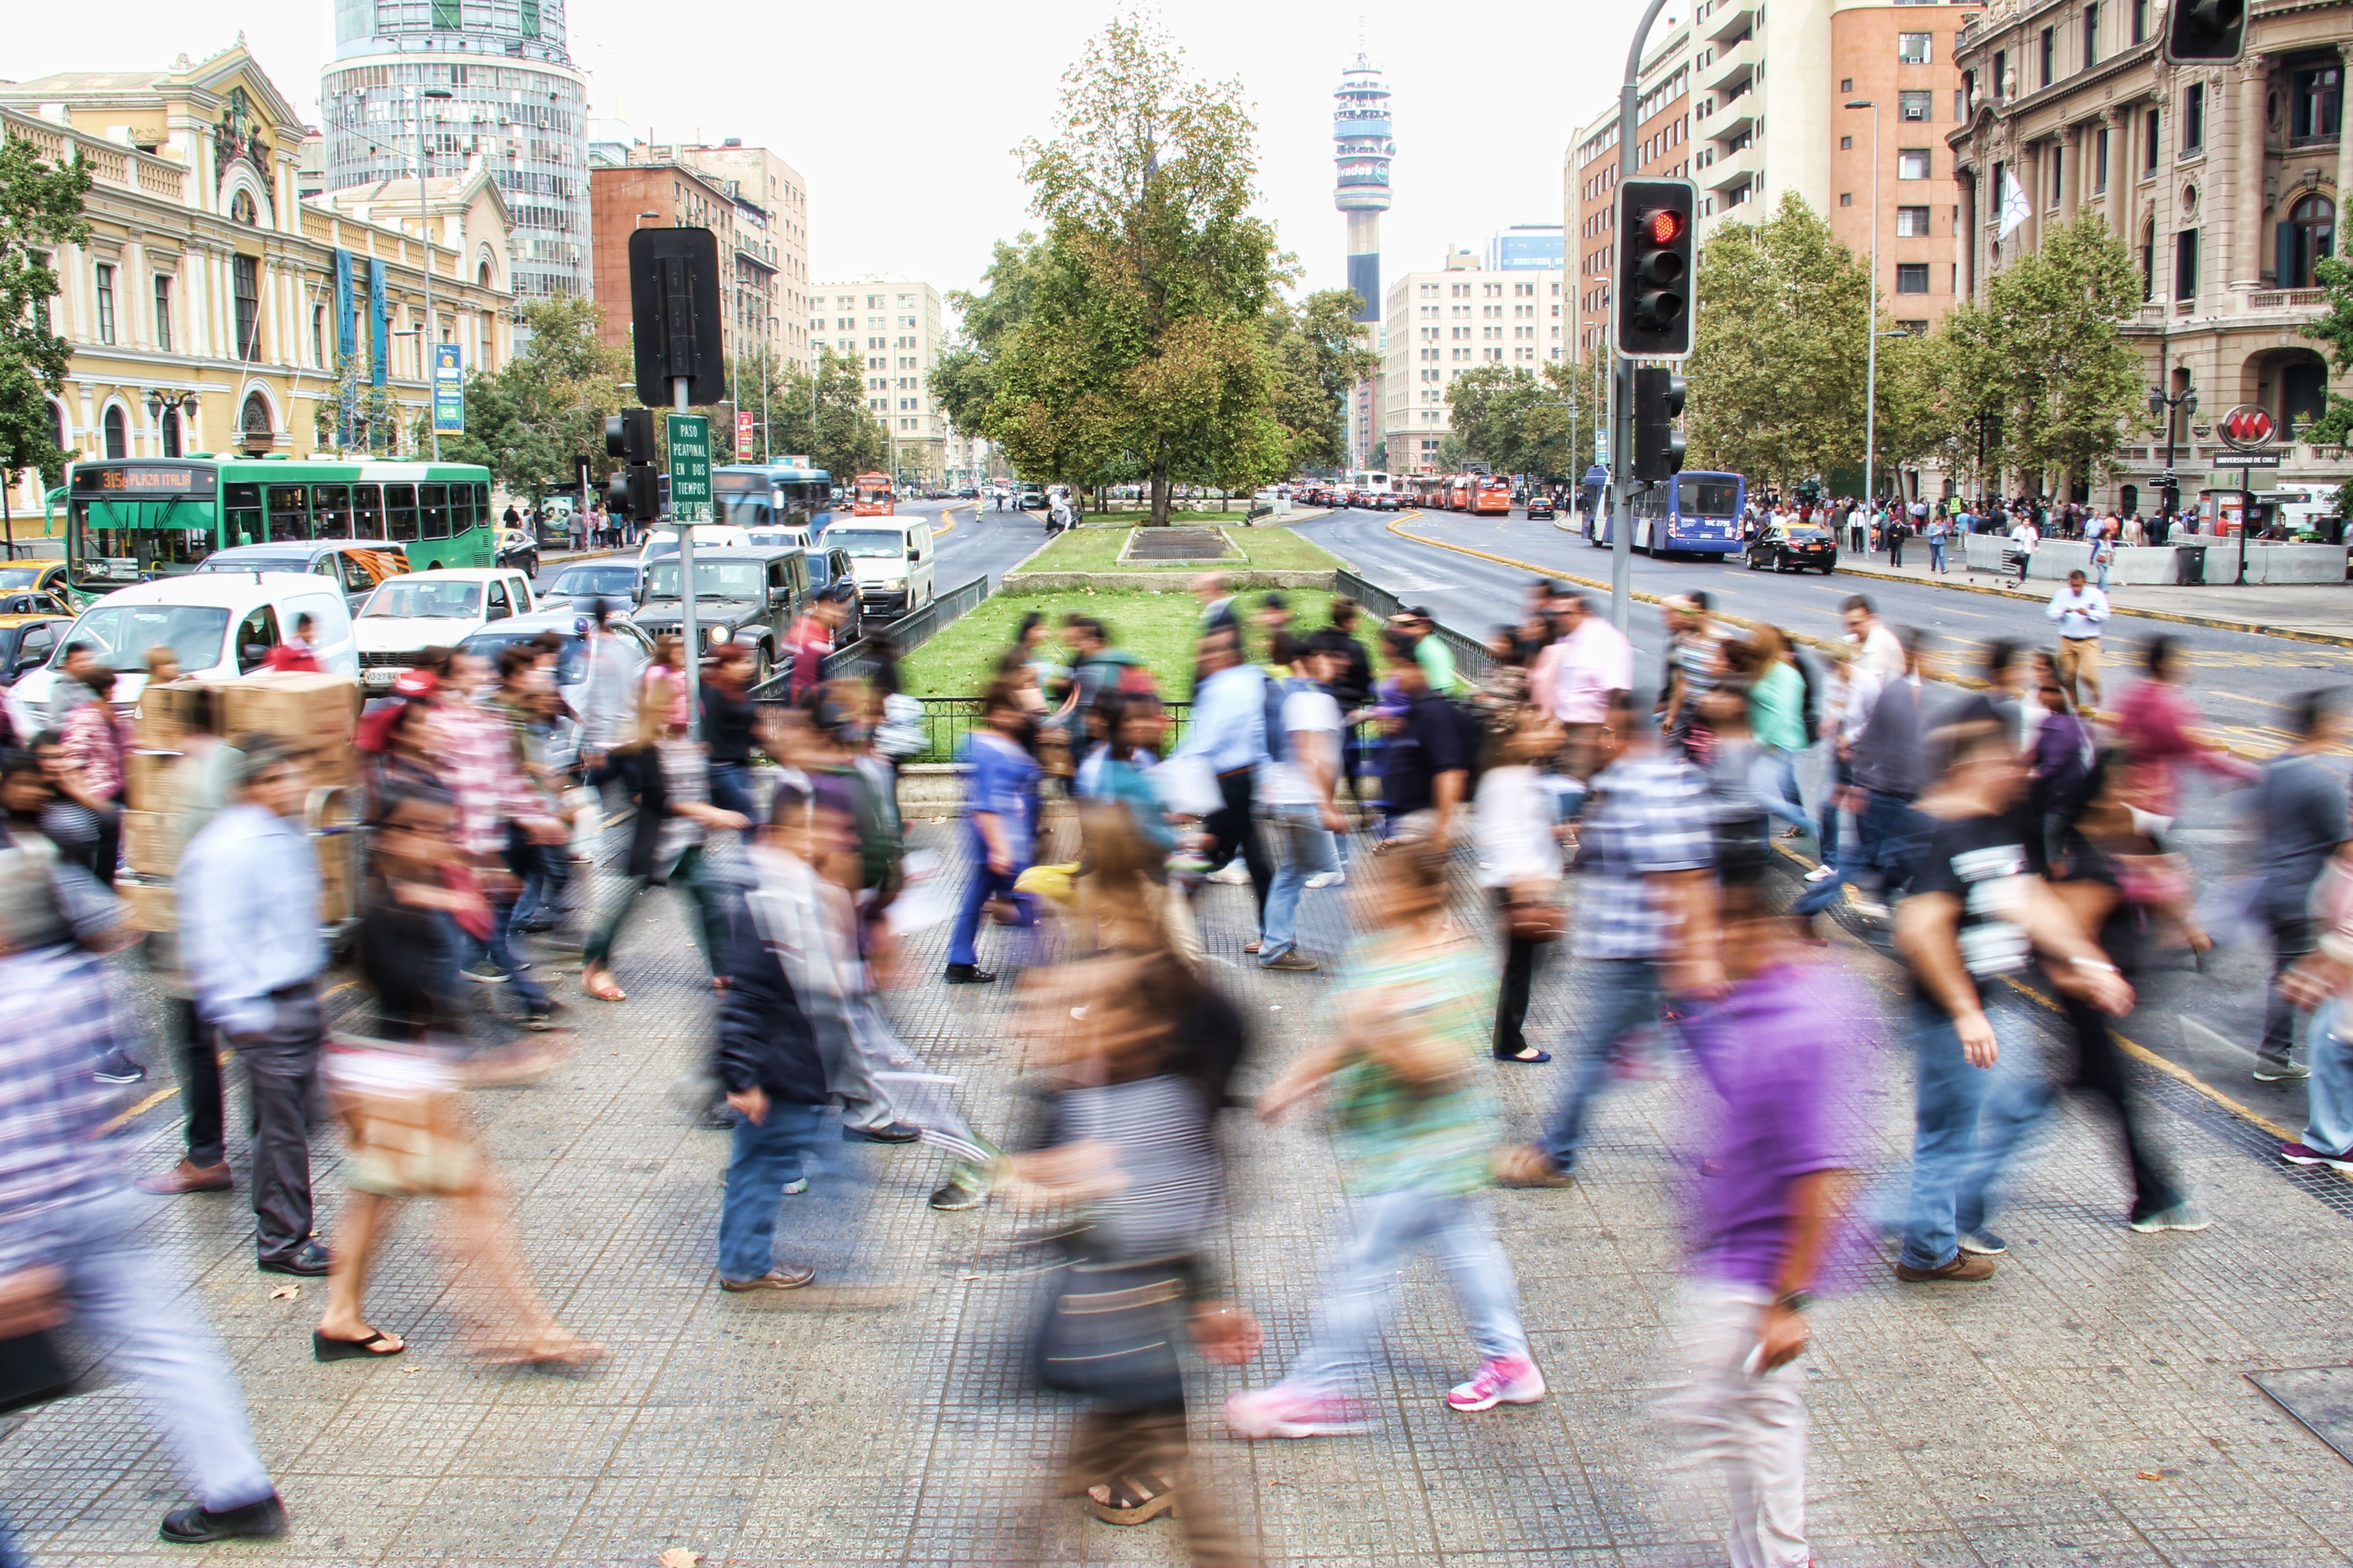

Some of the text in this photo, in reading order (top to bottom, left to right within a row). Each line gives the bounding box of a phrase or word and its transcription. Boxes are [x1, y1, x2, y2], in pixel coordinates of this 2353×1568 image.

[681, 424, 698, 437] PASO
[674, 443, 706, 457] PEATONAL
[676, 462, 706, 476] EN DOS
[103, 472, 191, 488] 315e PLAZA ITALIA
[677, 482, 706, 495] TIEMPOS
[672, 501, 680, 514] DE
[682, 501, 693, 514] LUZ
